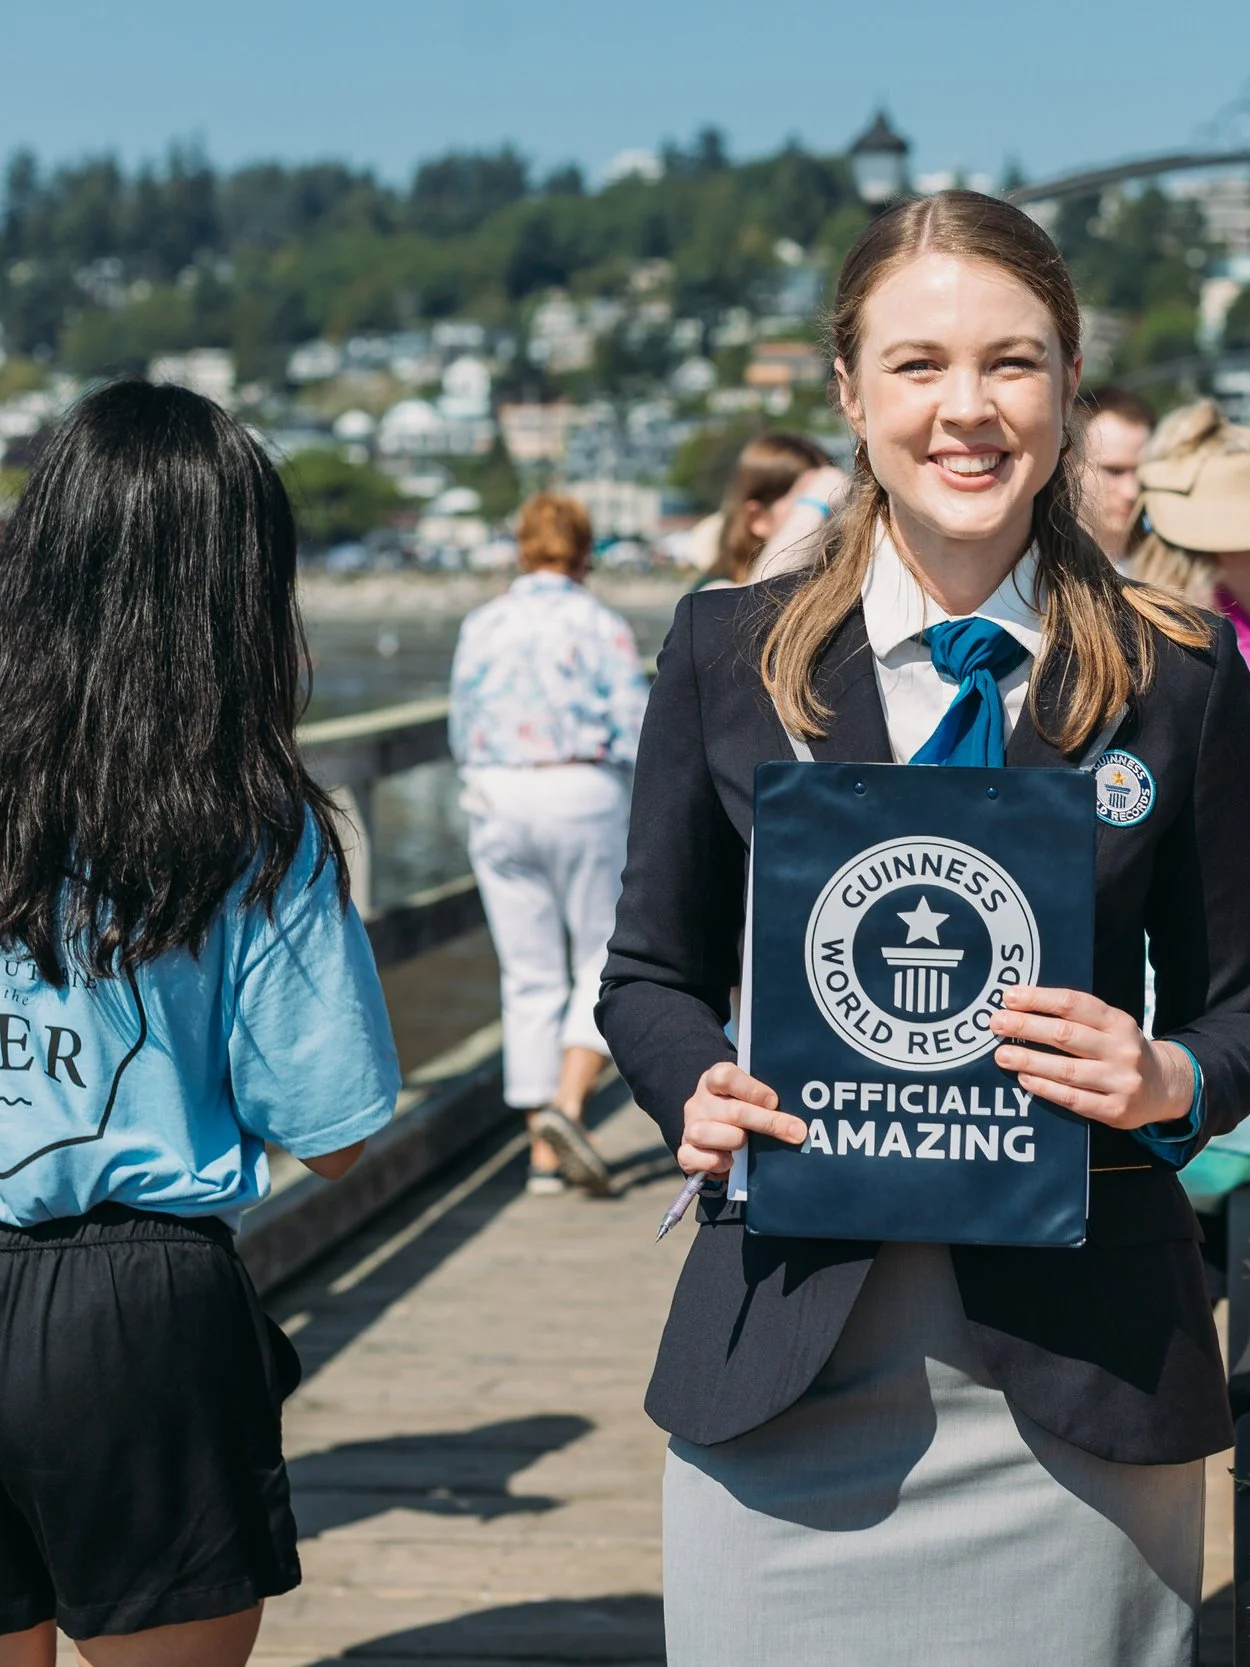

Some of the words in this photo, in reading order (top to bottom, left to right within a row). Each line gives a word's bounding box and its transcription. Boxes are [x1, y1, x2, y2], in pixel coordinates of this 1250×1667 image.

[1093, 754, 1147, 780] GUINNESS
[1111, 788, 1150, 821] RECORDS
[841, 852, 1008, 914] GUINNESS
[4, 988, 29, 1006] the
[821, 937, 893, 1045] WORLD
[0, 1013, 87, 1089] ER
[801, 1079, 1034, 1118] OFFICIALLY
[801, 1119, 1035, 1163] AMAZING
